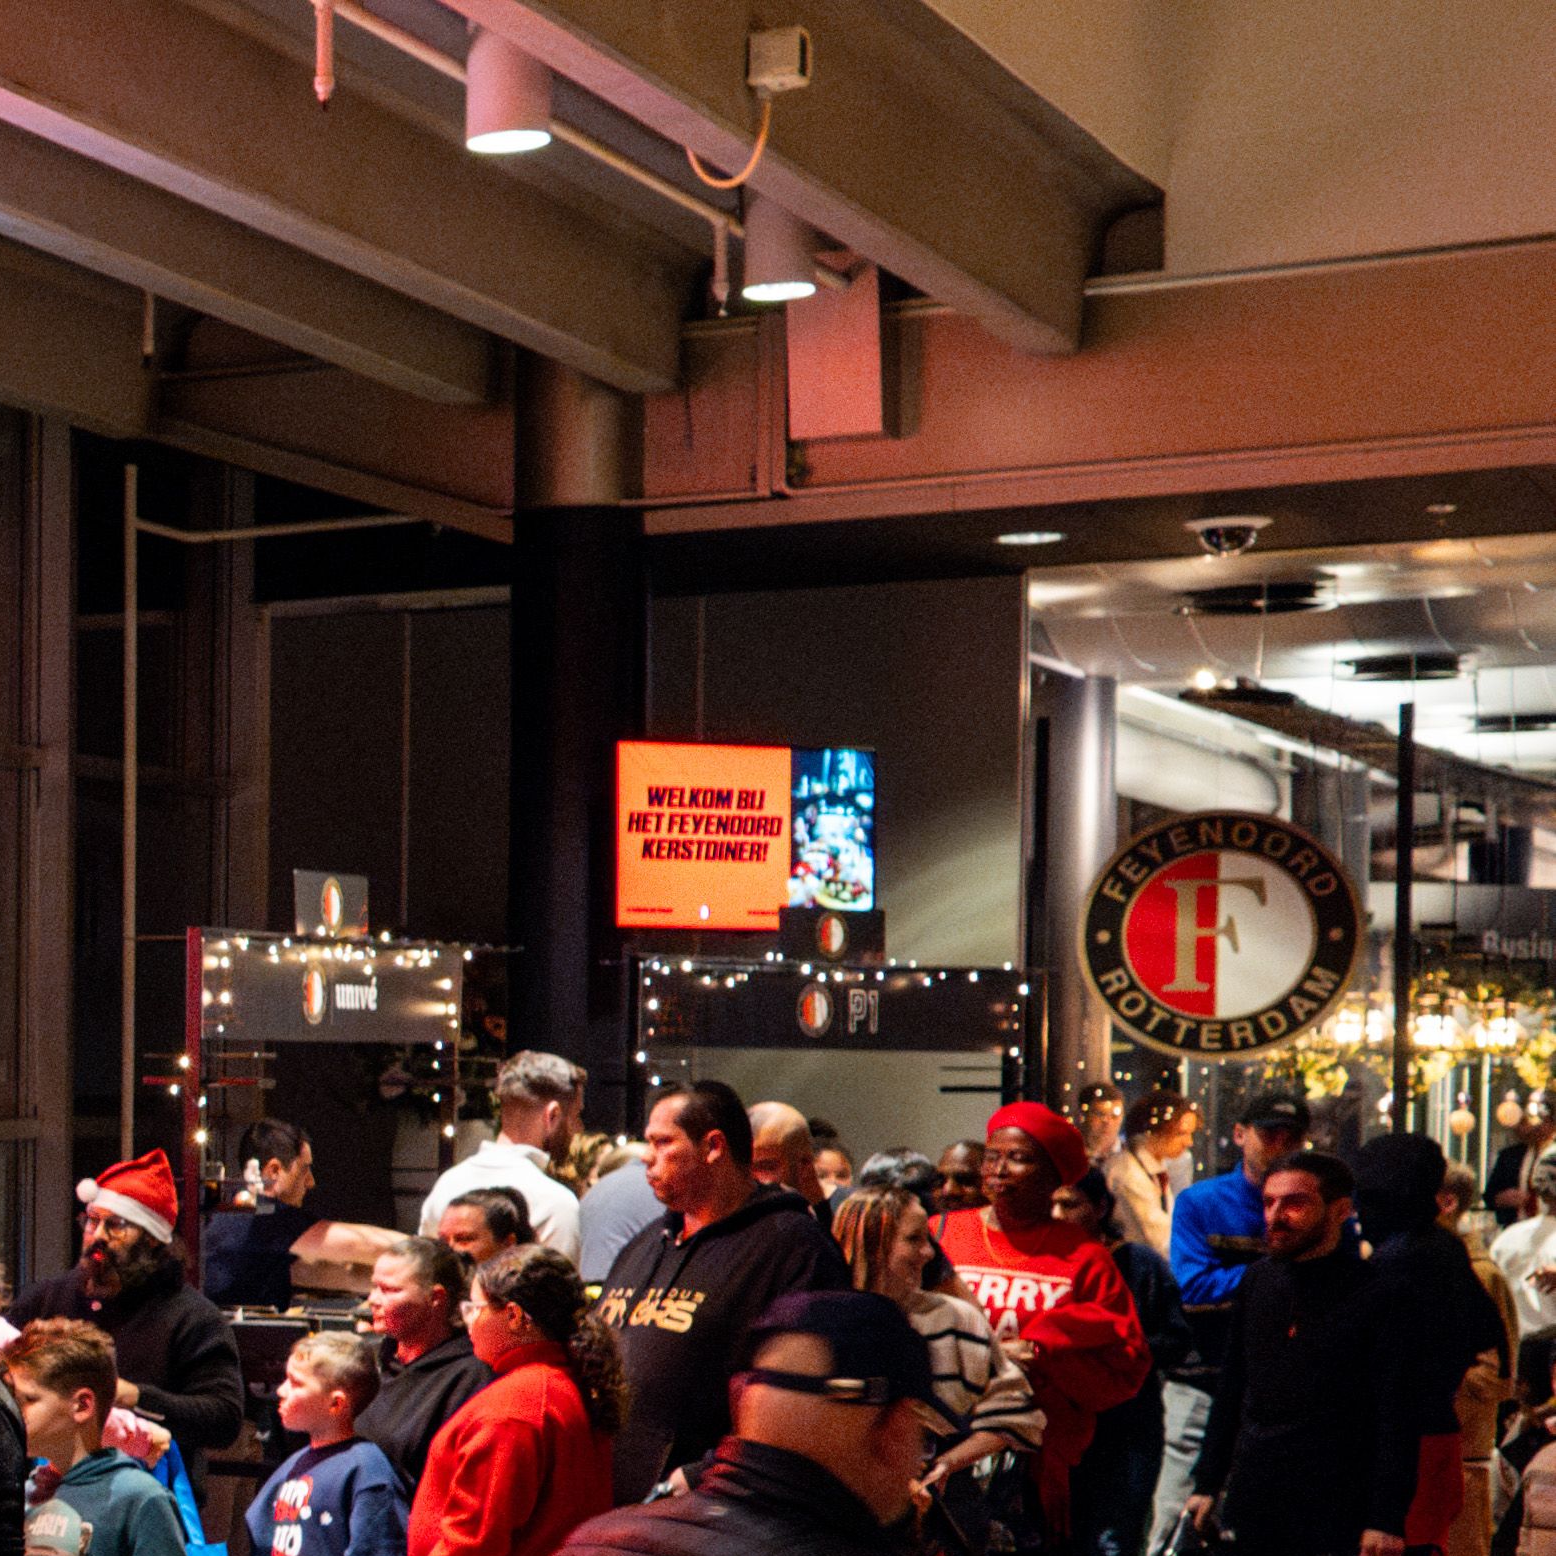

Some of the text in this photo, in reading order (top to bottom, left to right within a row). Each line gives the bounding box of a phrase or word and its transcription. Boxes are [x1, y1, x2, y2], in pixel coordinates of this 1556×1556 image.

[648, 786, 766, 811] WELKOM BIJ
[627, 812, 783, 837] HET FEYENOORD
[641, 838, 770, 862] KERSTDINER!
[1102, 820, 1338, 901] FEYENOORD
[1161, 877, 1268, 992] F
[848, 988, 879, 1034] P1
[1099, 965, 1339, 1049] ROTTERDAM
